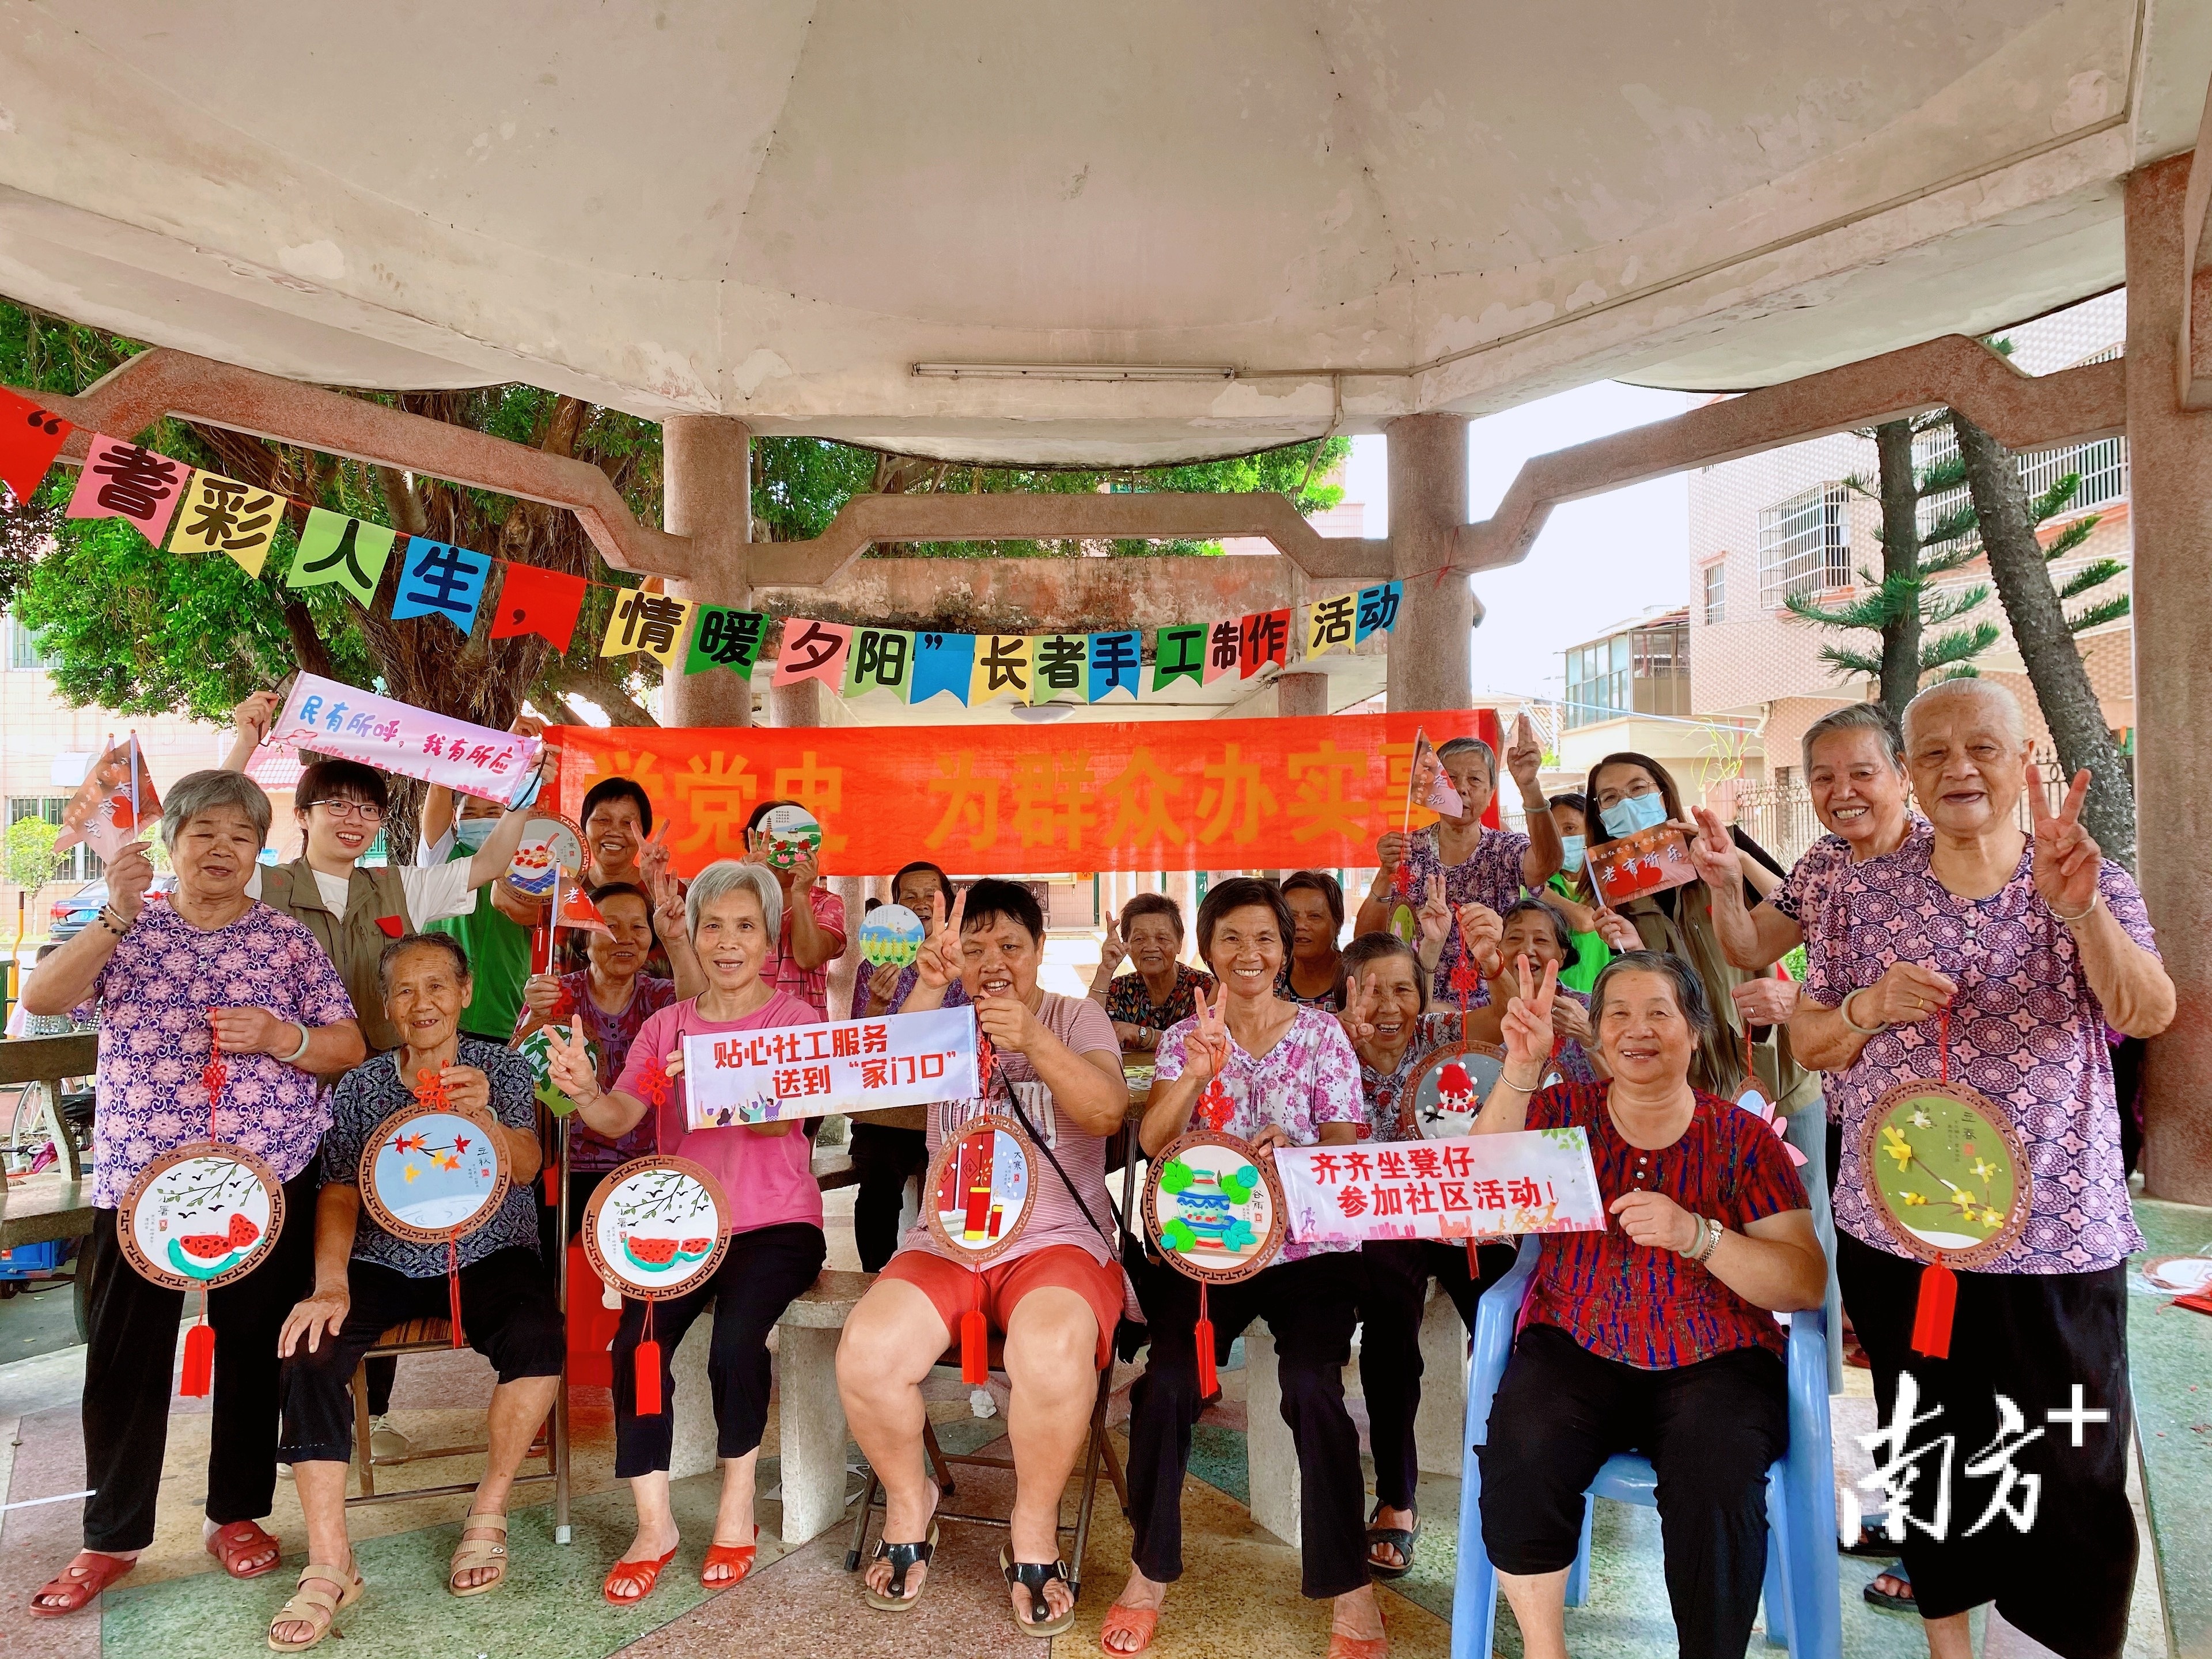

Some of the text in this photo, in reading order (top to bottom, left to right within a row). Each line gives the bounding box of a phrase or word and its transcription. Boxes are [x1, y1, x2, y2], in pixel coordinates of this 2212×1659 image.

[1601, 843, 1683, 885] 老有所乐
[714, 1024, 888, 1070] 贴心社工服务
[772, 1065, 831, 1099] 送到
[1013, 1152, 1022, 1171] 大寒
[1310, 1145, 1475, 1185] 齐齐坐凳仔
[1251, 1190, 1265, 1211] 谷雨
